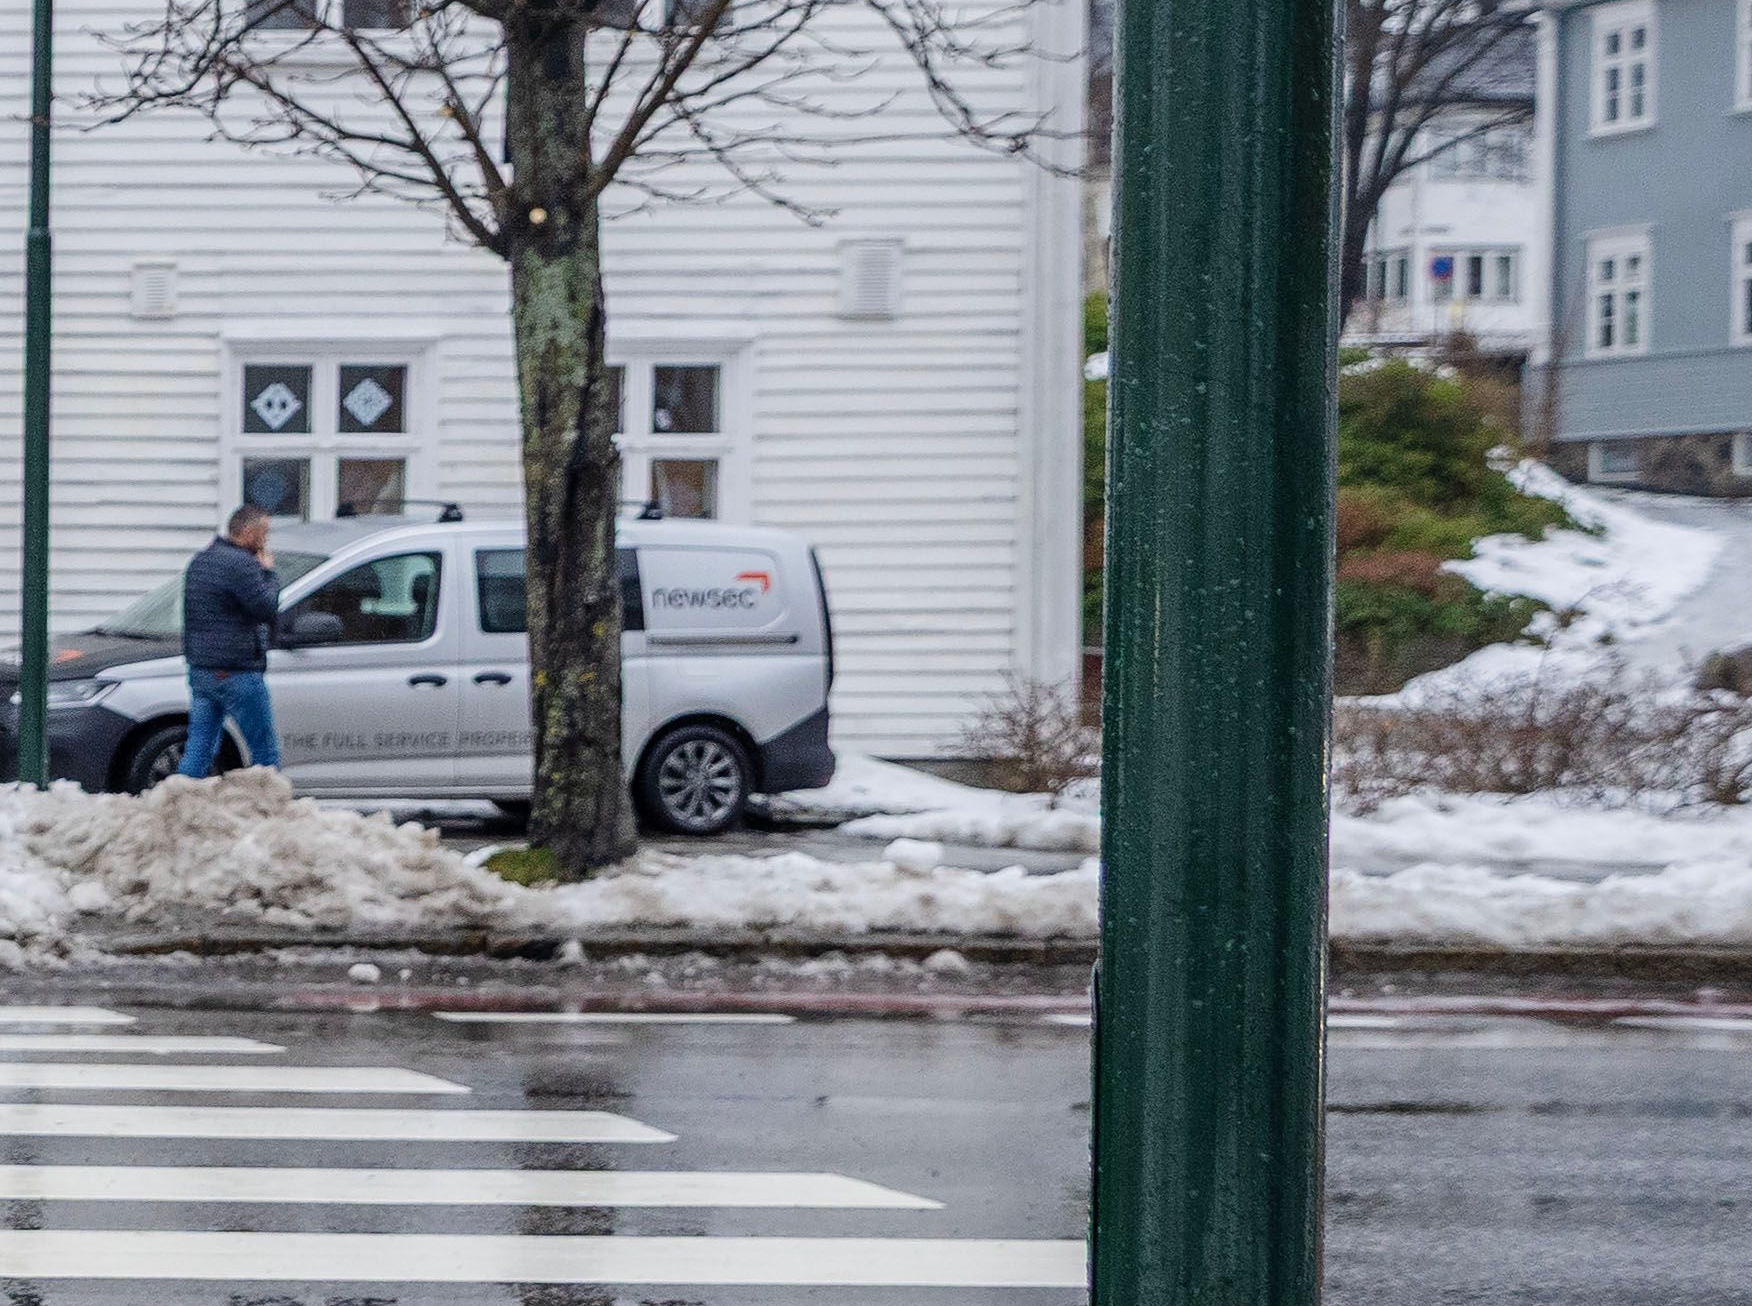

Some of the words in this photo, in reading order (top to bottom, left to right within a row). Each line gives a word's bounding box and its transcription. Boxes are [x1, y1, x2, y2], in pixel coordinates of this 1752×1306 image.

[652, 587, 756, 609] newsec
[322, 732, 367, 750] FULL
[373, 731, 449, 748] SERVICE
